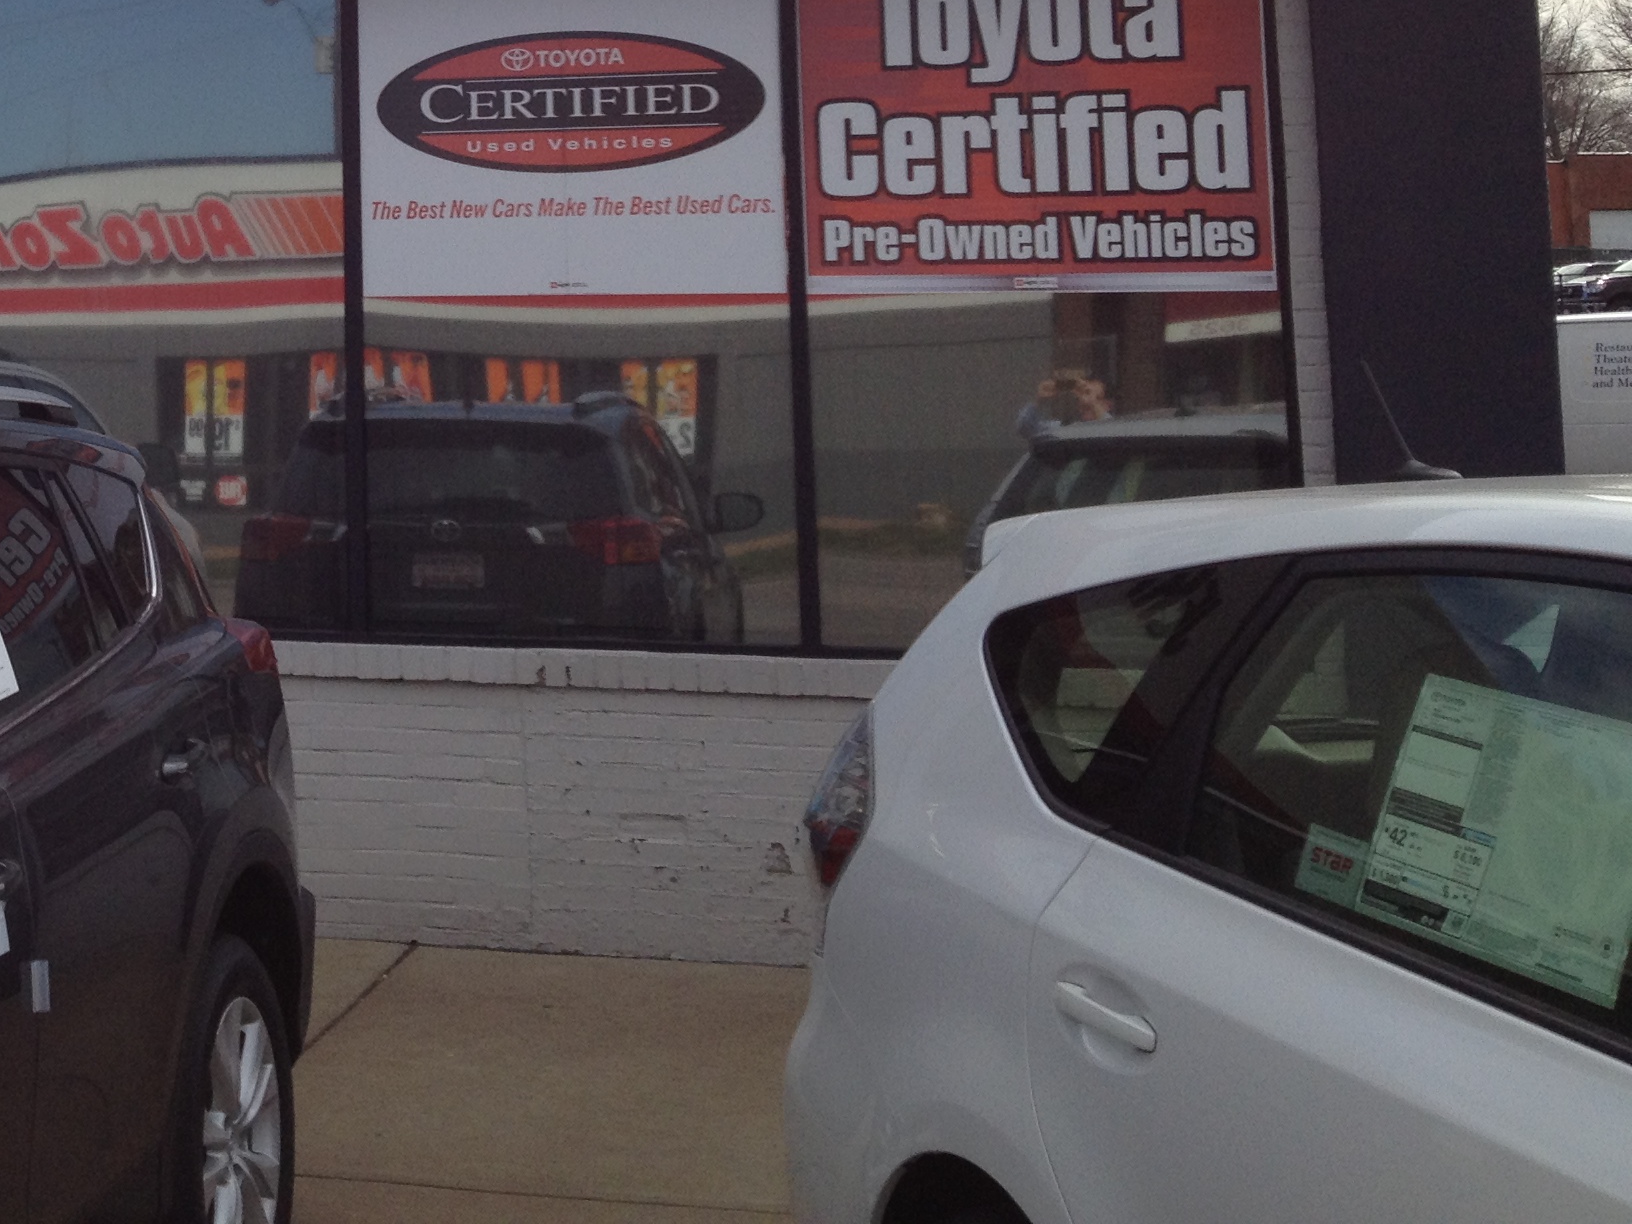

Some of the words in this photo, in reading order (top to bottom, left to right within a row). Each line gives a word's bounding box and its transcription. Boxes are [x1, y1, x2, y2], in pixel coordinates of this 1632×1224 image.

[536, 47, 625, 68] TOYOTA
[419, 82, 721, 123] CERTIFIED
[467, 138, 535, 153] Used
[548, 135, 674, 151] Vehicles
[817, 88, 1253, 197] Certified
[371, 201, 402, 220] The
[406, 200, 446, 219] Best
[449, 199, 488, 218] New
[492, 198, 534, 218] Cars
[537, 197, 588, 217] Make
[593, 196, 625, 216] The
[629, 195, 671, 215] Best
[676, 194, 724, 214] Used
[727, 194, 777, 214] Cars.
[822, 215, 1061, 263] Pre-Owned
[1070, 212, 1257, 260] Vehicles
[1592, 377, 1614, 388] and
[1389, 826, 1408, 848] 42
